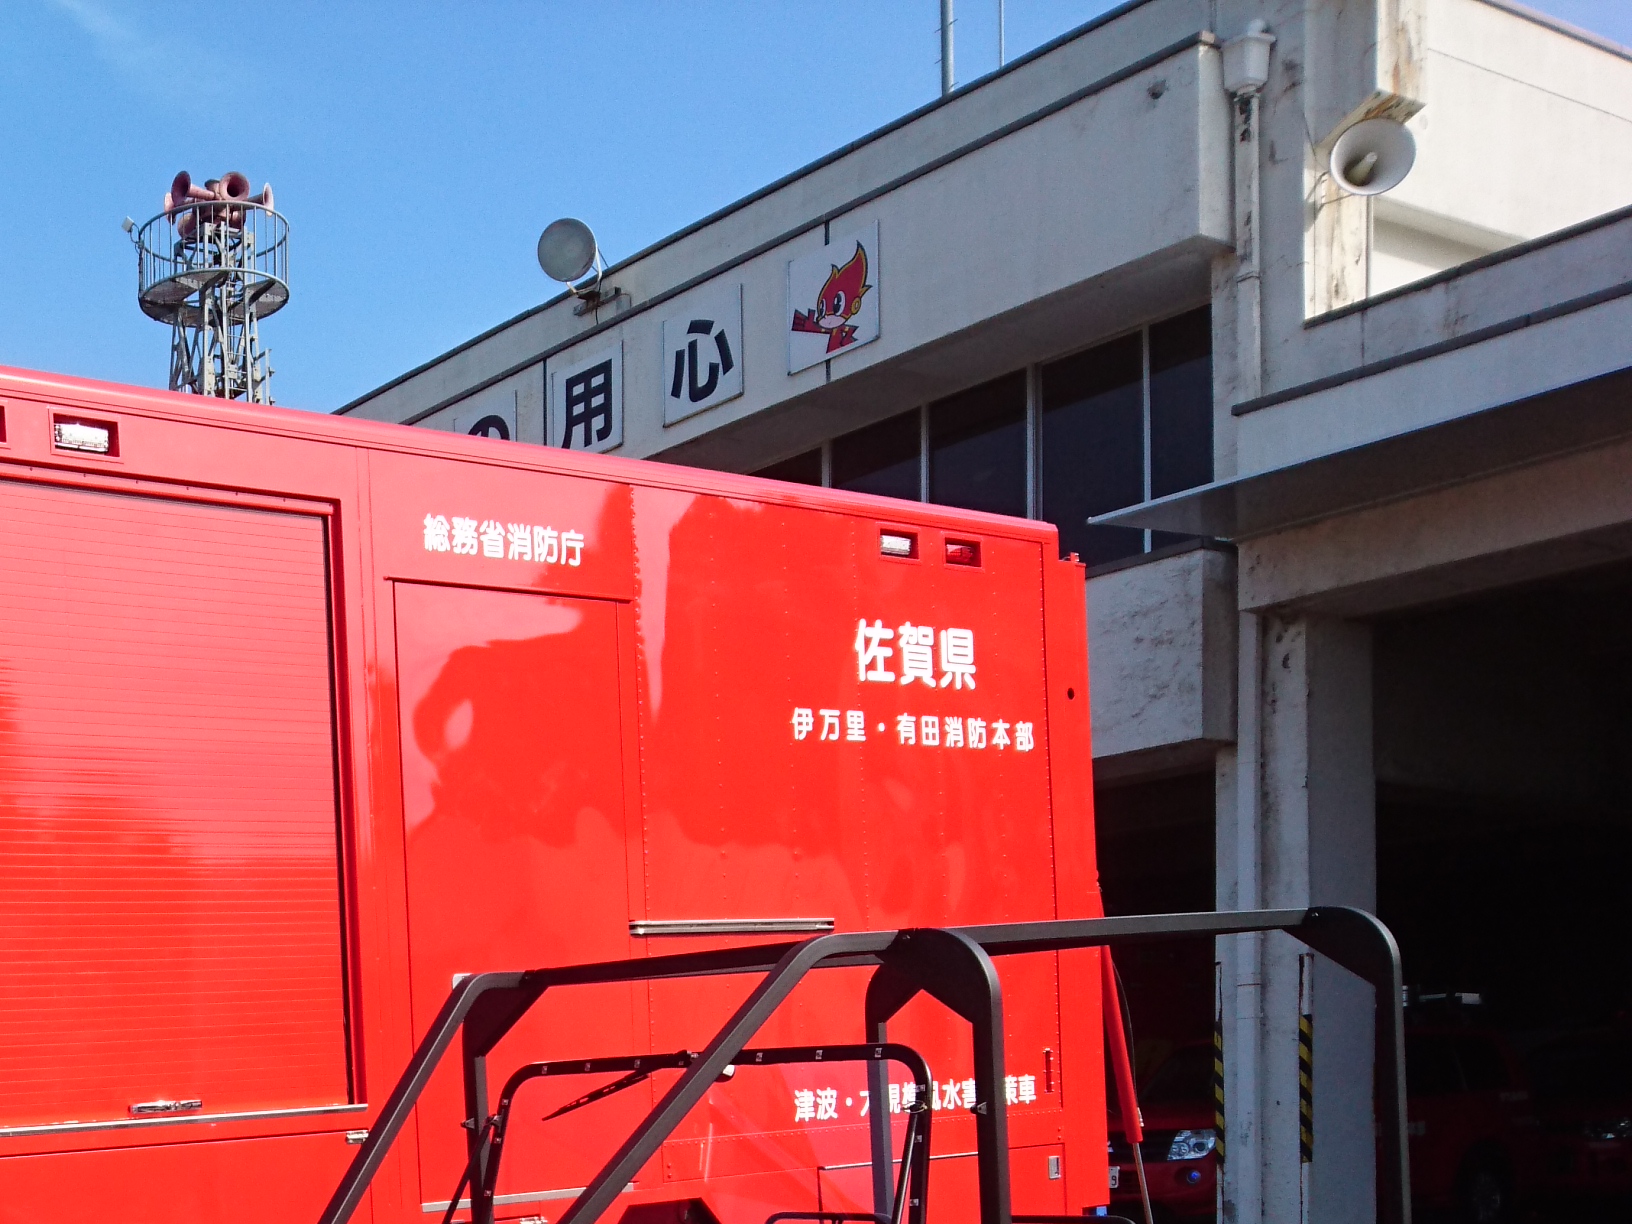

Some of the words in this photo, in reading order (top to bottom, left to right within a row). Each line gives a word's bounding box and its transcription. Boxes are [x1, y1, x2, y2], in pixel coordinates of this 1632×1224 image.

[423, 513, 585, 567] 総務省消防庁
[854, 618, 976, 690] 佐賀県
[791, 707, 1035, 752] 伊万里・有田消防本部
